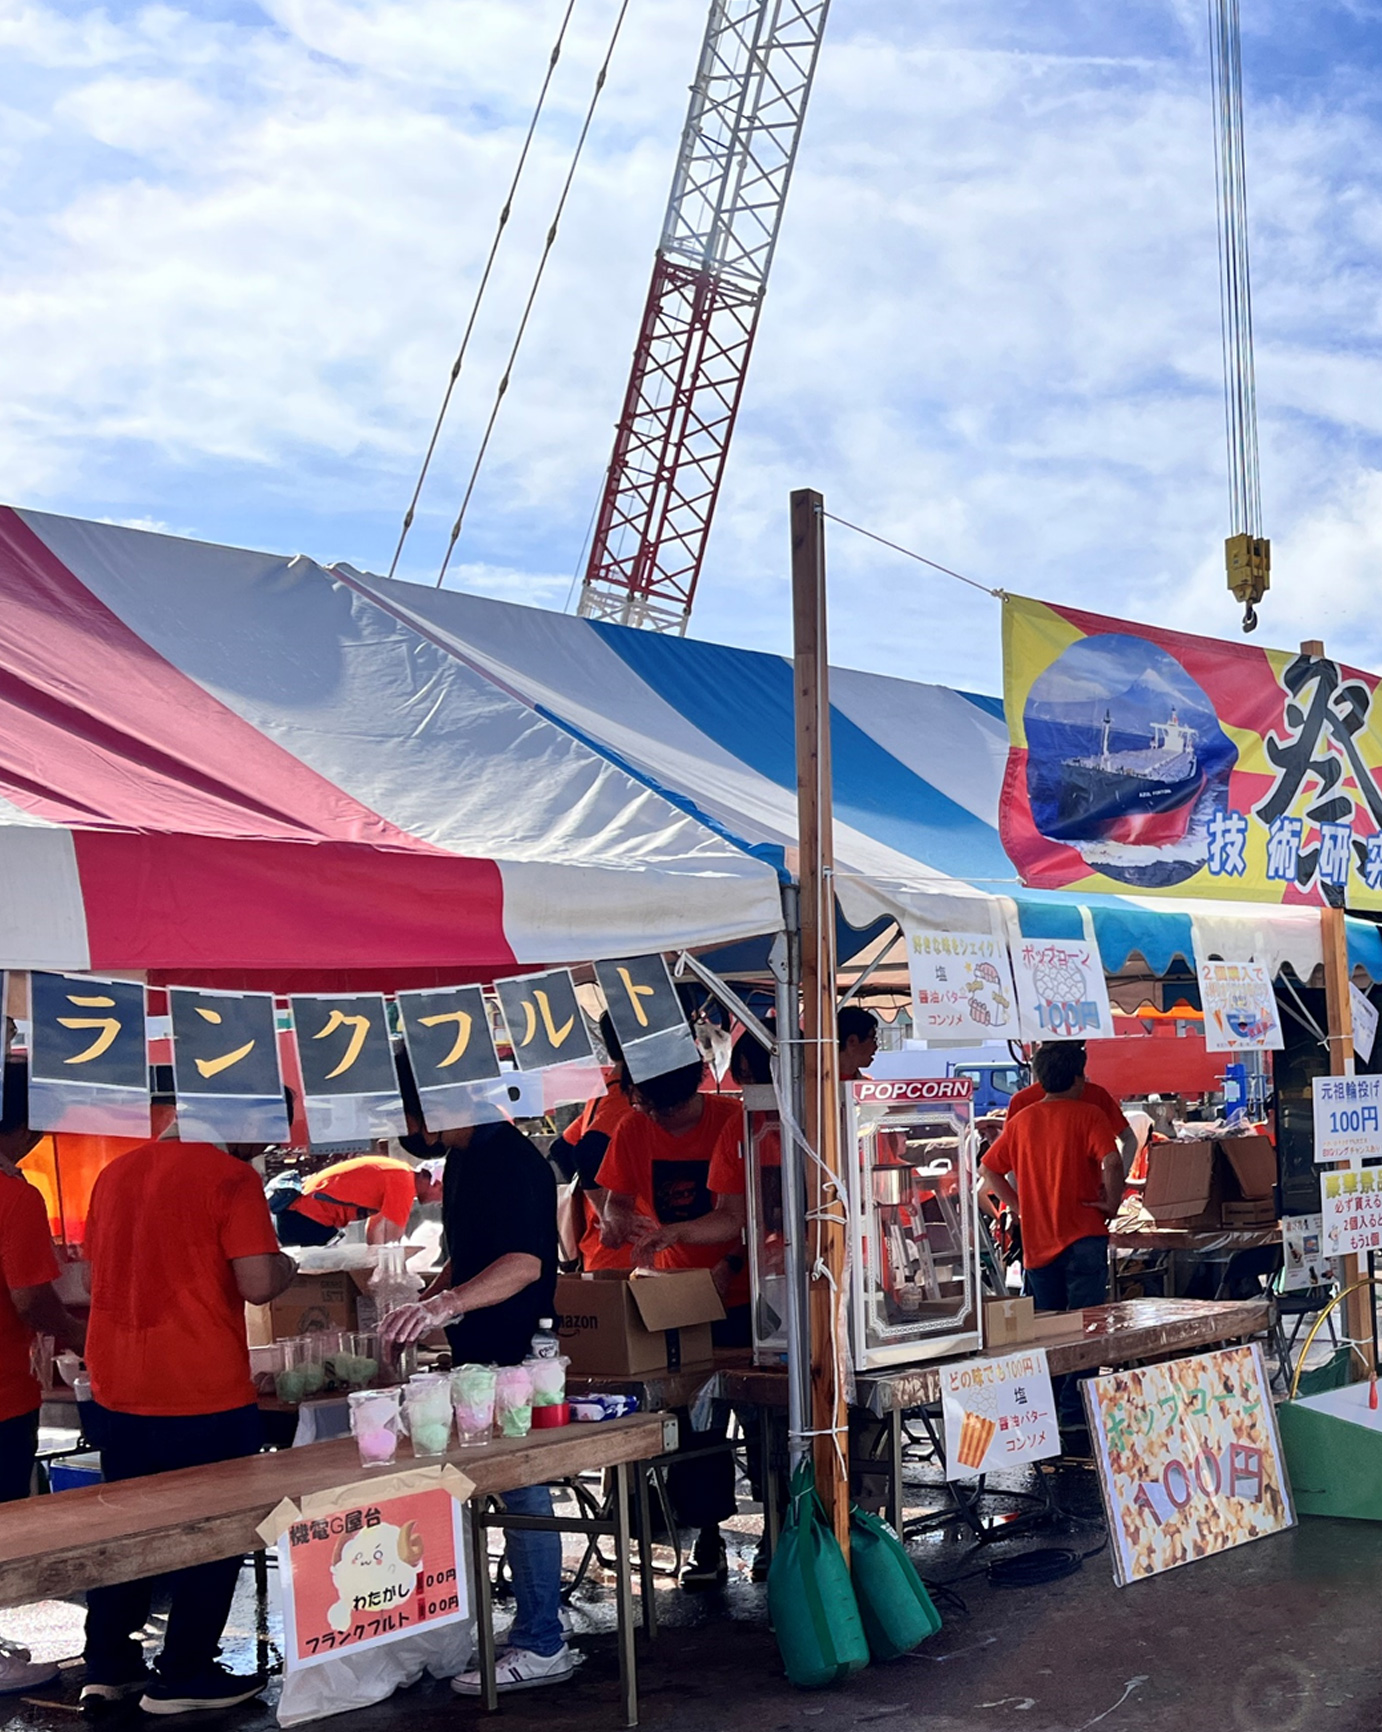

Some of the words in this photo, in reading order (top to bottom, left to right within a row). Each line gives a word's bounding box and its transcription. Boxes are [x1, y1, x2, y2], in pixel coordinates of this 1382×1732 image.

[1022, 944, 1090, 966] ポップコーン
[936, 965, 947, 981] 塩
[919, 990, 968, 1004] 醤油バター
[57, 967, 654, 1079] ランクフルト
[928, 1014, 962, 1026] コンソメ
[1034, 1001, 1100, 1029] 100円
[860, 1081, 968, 1100] POPCORN
[1322, 1080, 1380, 1099] 元祖輪投げ
[1330, 1106, 1378, 1133] 100円
[1014, 1387, 1028, 1404] 塩
[999, 1410, 1048, 1431] 醤油バター
[1107, 1382, 1260, 1452] ポップコーン
[1006, 1431, 1046, 1452] コンソメ
[1133, 1443, 1263, 1527] 100円
[290, 1507, 381, 1546] 機電G屋台
[353, 1584, 410, 1612] わたがし
[306, 1612, 410, 1653] フランクフルト
